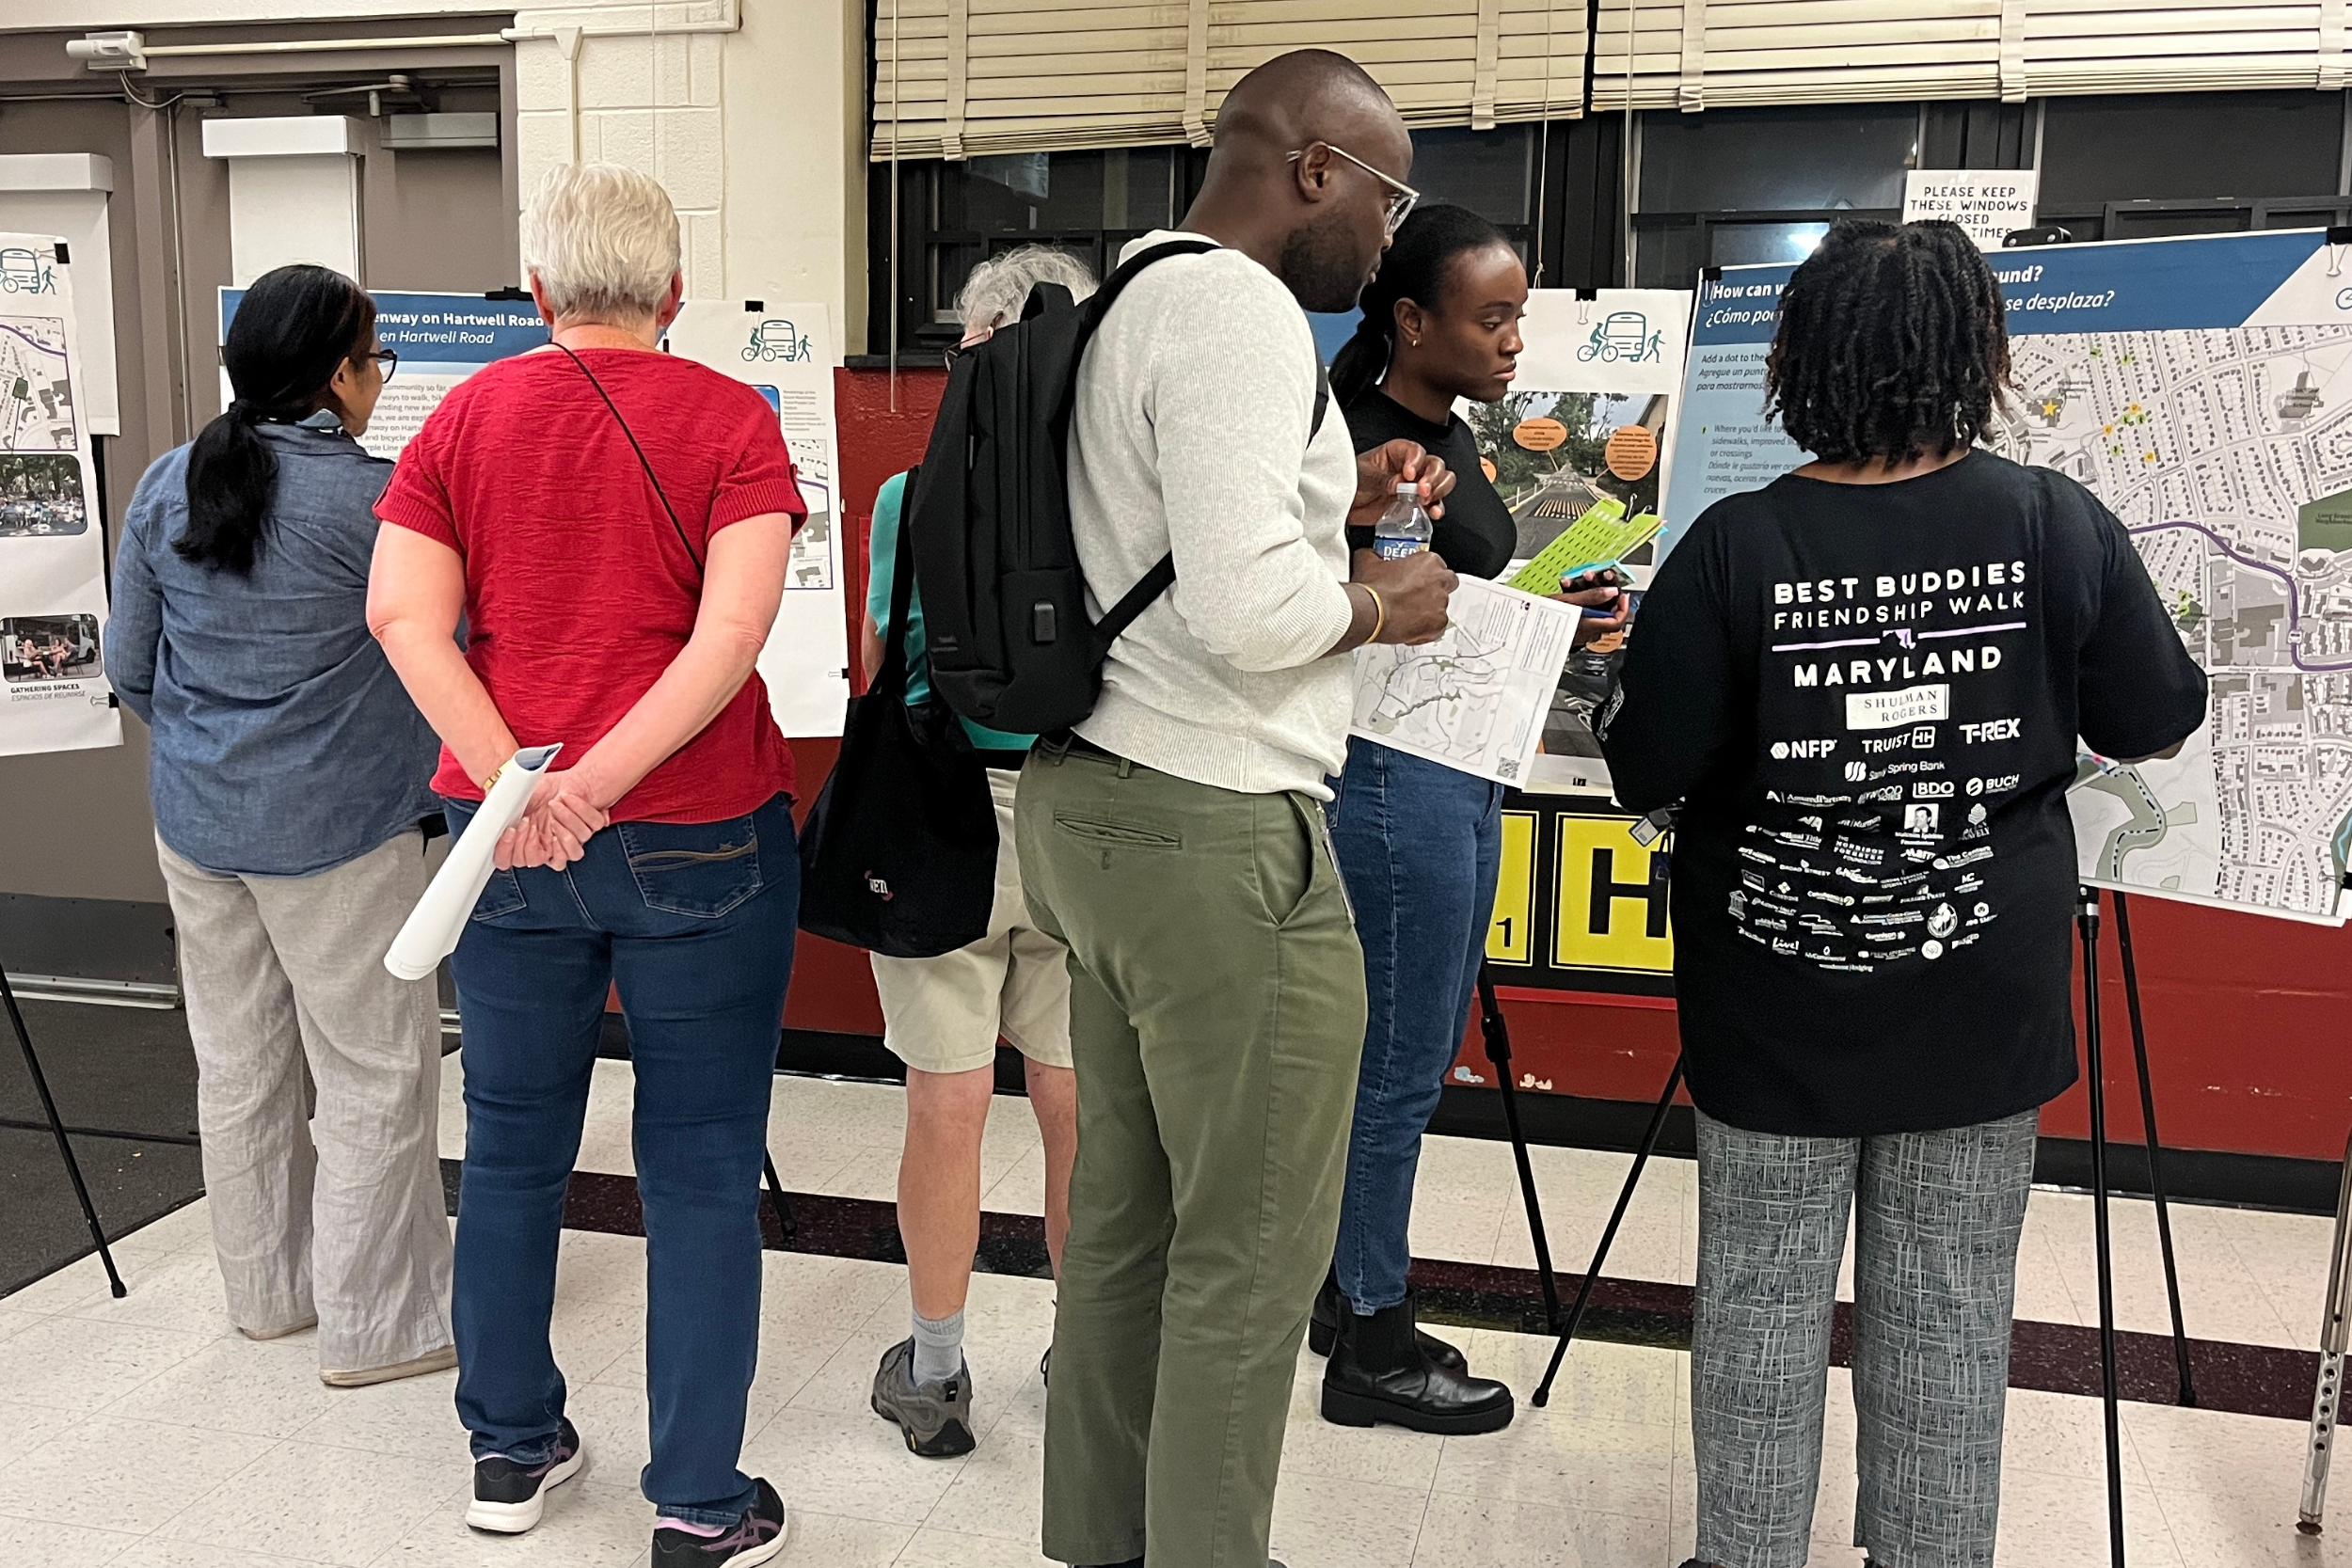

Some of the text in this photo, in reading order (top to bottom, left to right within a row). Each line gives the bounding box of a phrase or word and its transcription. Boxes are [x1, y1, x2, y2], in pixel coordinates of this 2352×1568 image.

[1924, 186, 2016, 198] PLEASE KEEP
[1911, 199, 2028, 212] THESE WINDOWS
[1713, 284, 1743, 299] How
[1746, 284, 1772, 296] can
[2005, 290, 2115, 314] se desplaza?
[421, 314, 440, 325] on
[443, 312, 505, 326] Hartwell
[1706, 307, 1750, 328] ¿Cómo
[379, 330, 495, 344] en Hartwell Road
[1701, 355, 1717, 364] Add
[1724, 354, 1739, 363] dot
[1740, 354, 1749, 362] to
[1751, 353, 1765, 362] the
[1696, 382, 1715, 392] para
[1714, 424, 1737, 433] Where
[1774, 561, 2026, 605] BEST BUDDIES
[1774, 591, 2025, 630] FRIENDSHIP WALK
[1794, 645, 2002, 688] MARYLAND
[10, 683, 80, 694] GATHERING SPACES
[1864, 689, 1938, 709] SHULMAN
[1881, 704, 1938, 723] ROGERS
[1959, 718, 2022, 744] T-REX
[1791, 739, 1836, 759] NFP
[1862, 732, 1911, 754] TRUIST
[1887, 762, 1918, 774] Spring
[1919, 760, 1945, 771] Bank
[1917, 781, 1955, 795] BDO
[1985, 773, 2020, 789] BUCH
[1588, 847, 1669, 939] H
[1496, 917, 1512, 947] 1
